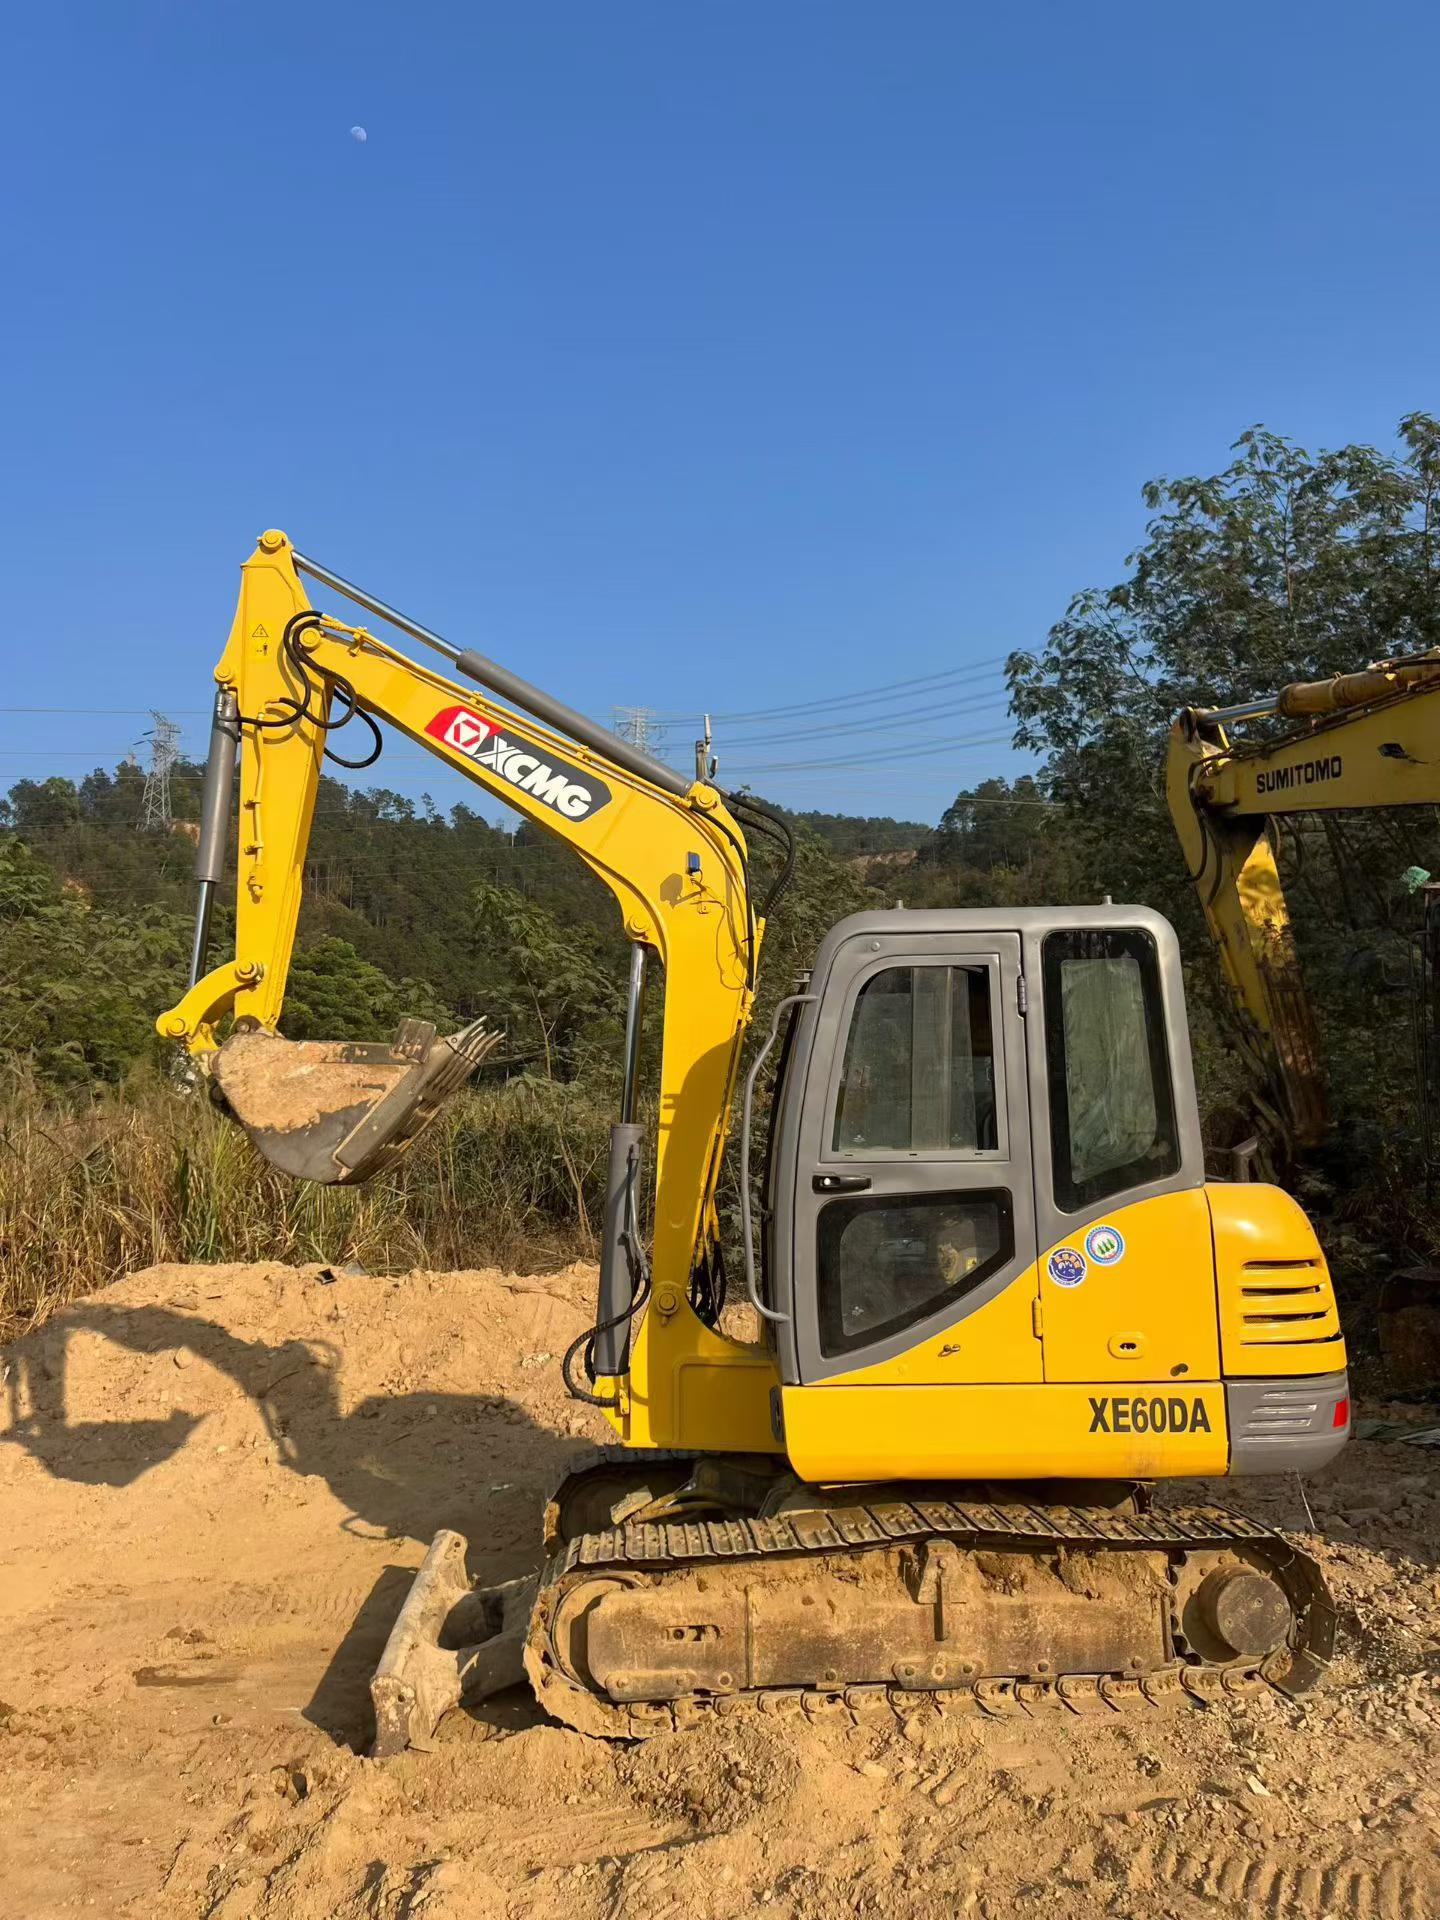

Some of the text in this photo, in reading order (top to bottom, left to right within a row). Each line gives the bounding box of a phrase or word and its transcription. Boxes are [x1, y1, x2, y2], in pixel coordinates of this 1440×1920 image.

[473, 735, 592, 817] XCMG
[1256, 755, 1342, 794] SUMITOMO
[1088, 1397, 1212, 1433] XE60DA
